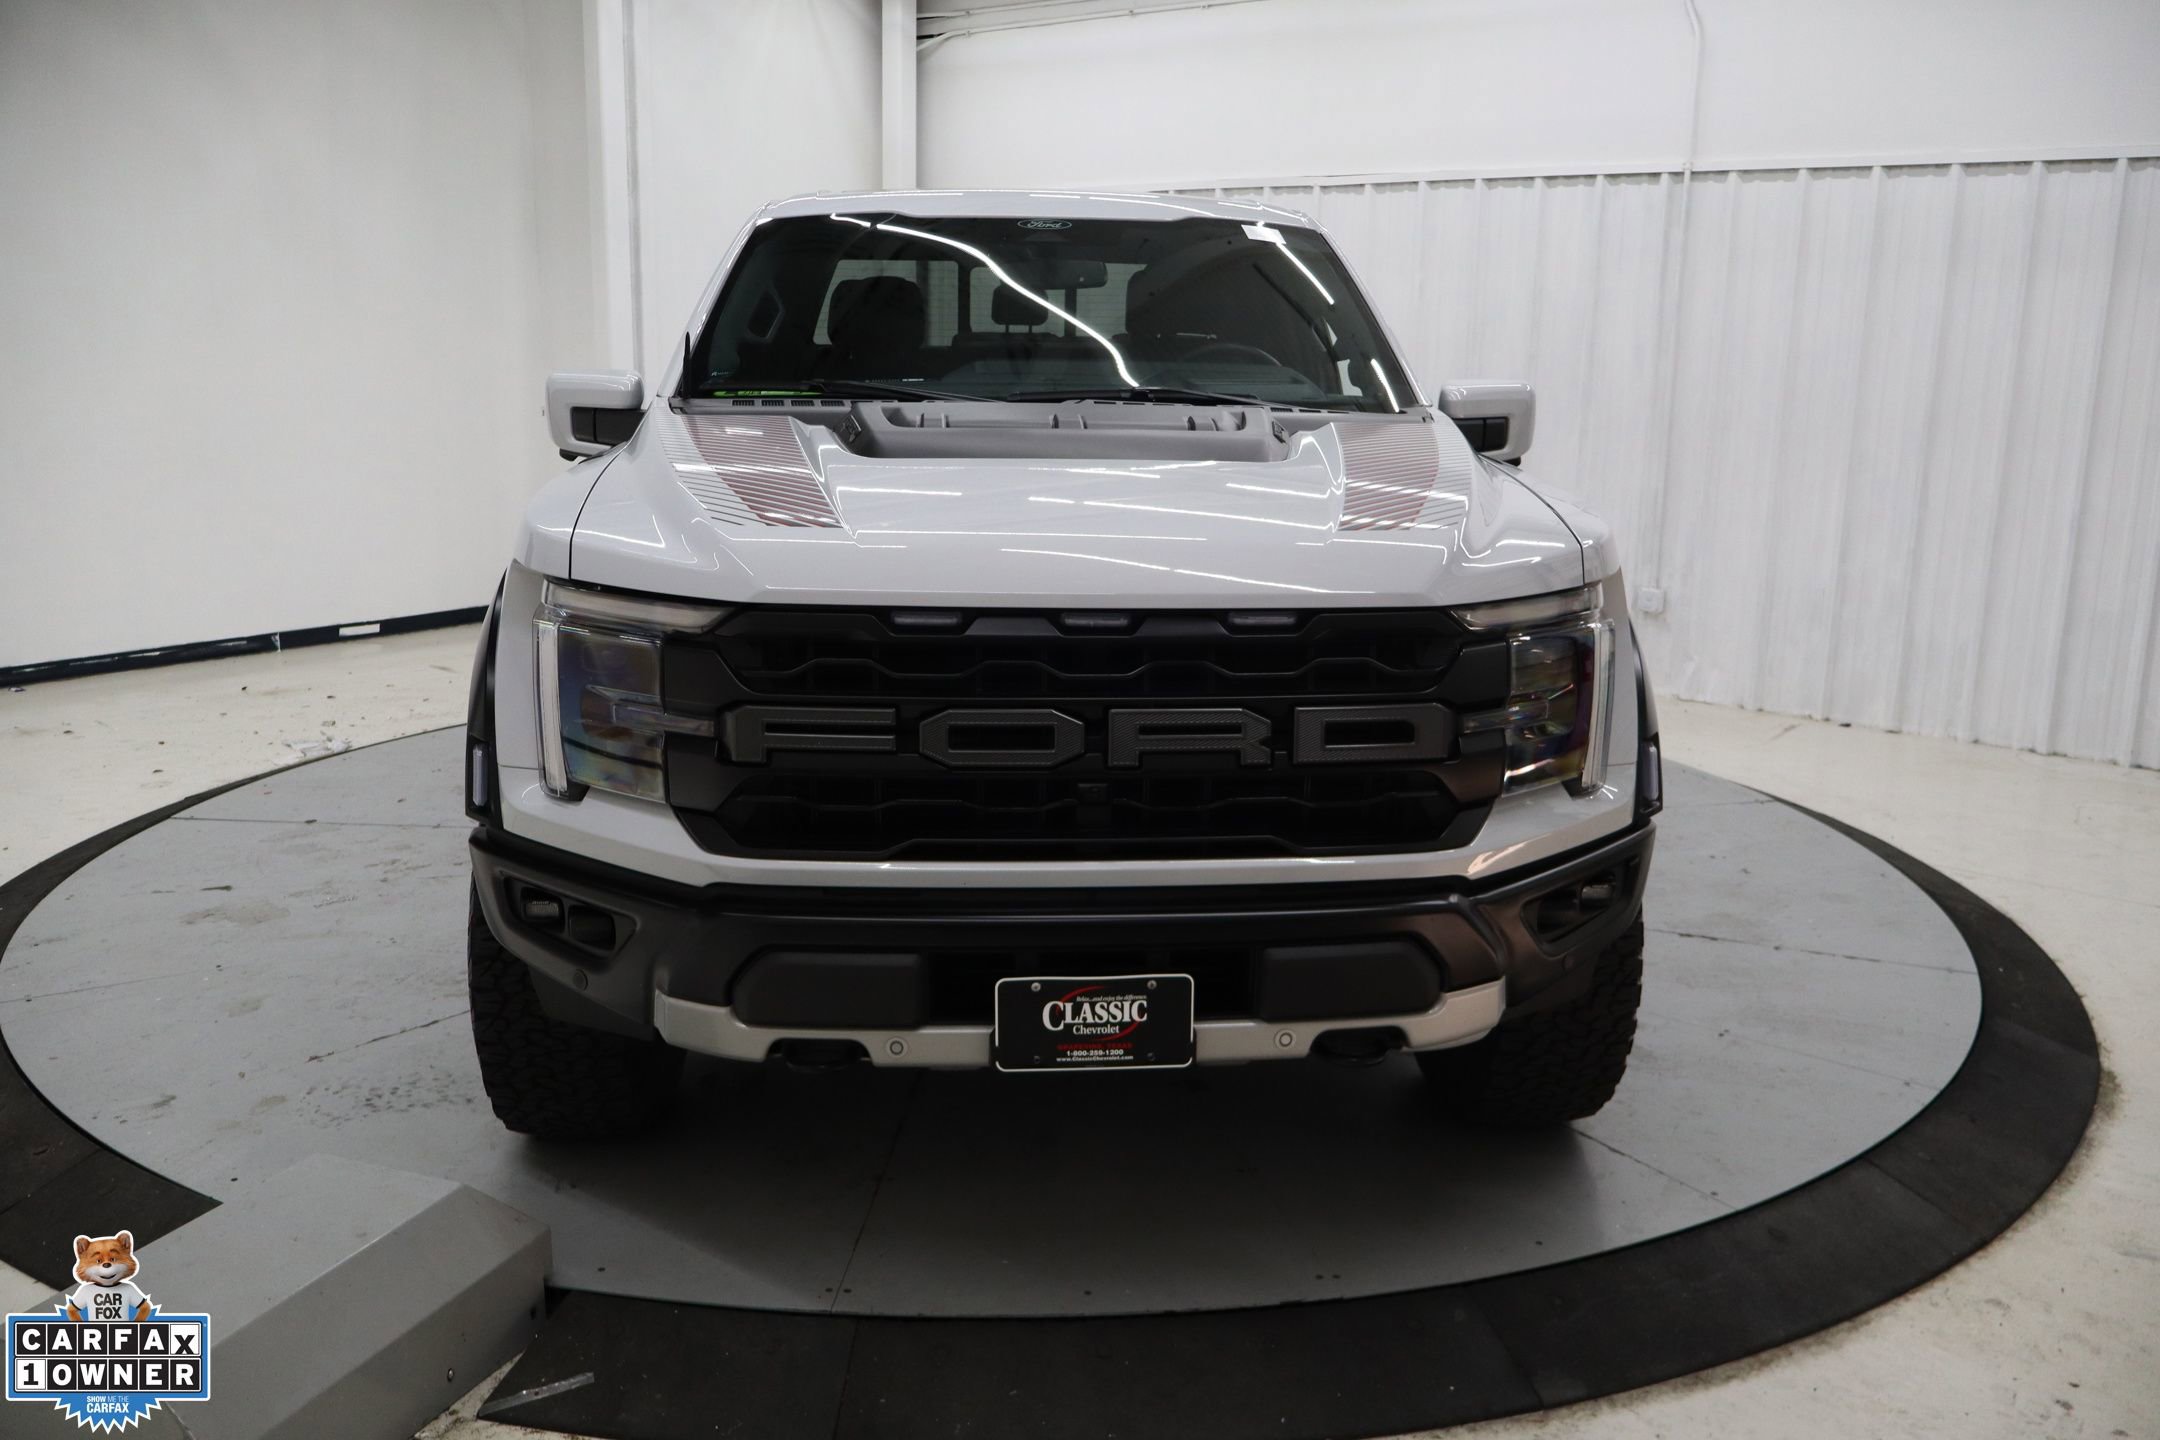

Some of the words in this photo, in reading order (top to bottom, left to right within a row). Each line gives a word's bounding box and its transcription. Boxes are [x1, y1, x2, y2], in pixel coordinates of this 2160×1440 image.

[1027, 219, 1062, 229] Ford
[722, 702, 1453, 770] FORD
[1042, 1000, 1148, 1031] CLASSIC
[1073, 1024, 1120, 1035] Chevrolet
